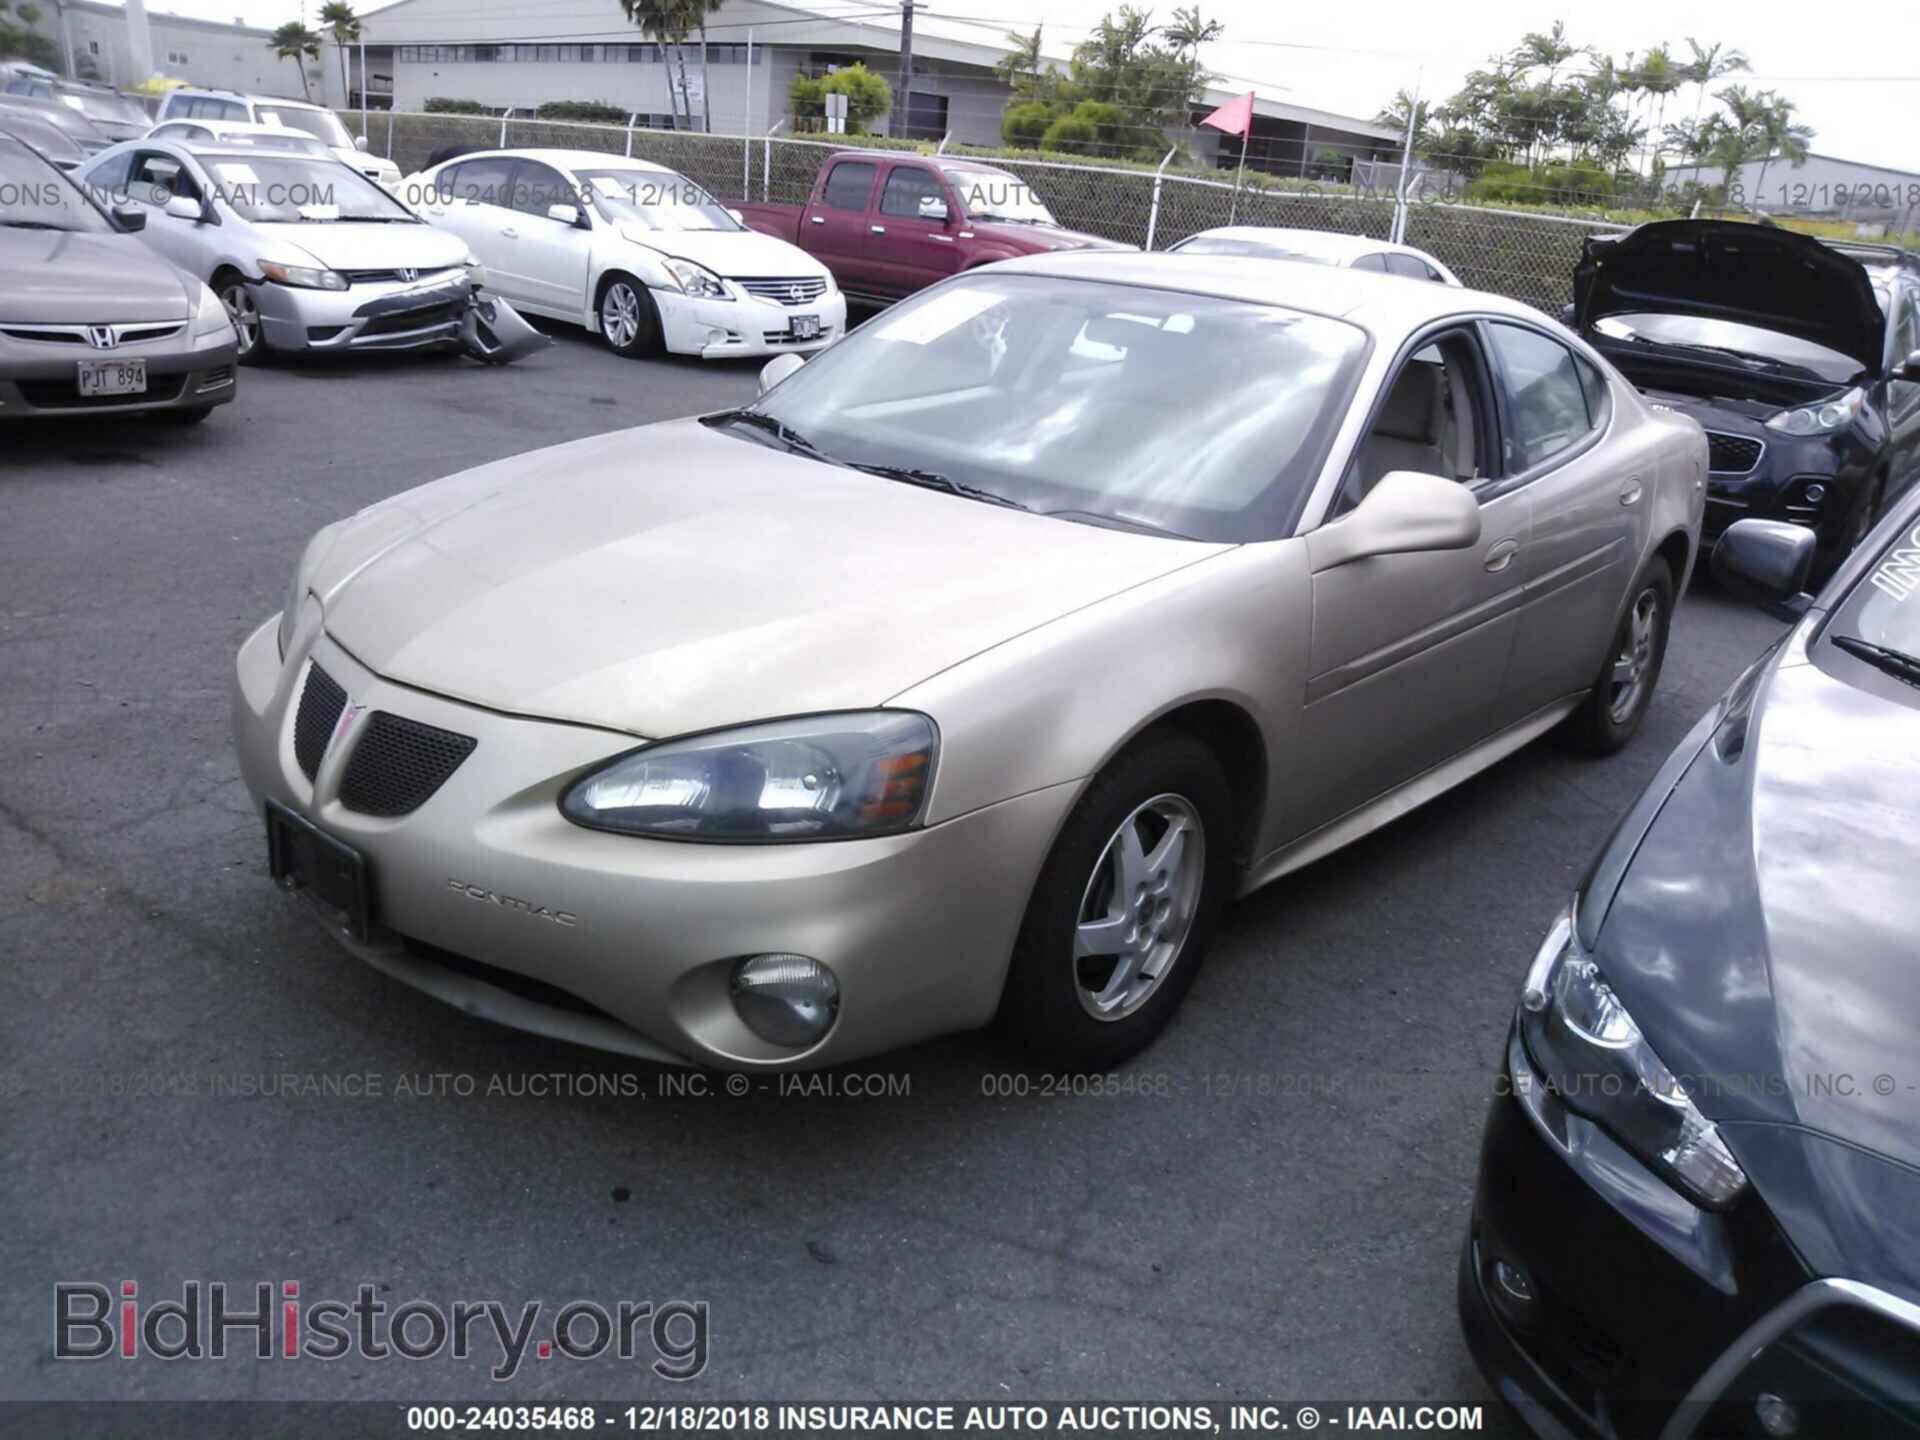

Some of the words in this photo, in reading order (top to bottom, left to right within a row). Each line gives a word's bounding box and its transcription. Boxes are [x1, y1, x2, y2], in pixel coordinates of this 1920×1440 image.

[82, 369, 108, 389] PJT
[118, 367, 144, 386] 894
[447, 878, 577, 928] PONTIAC
